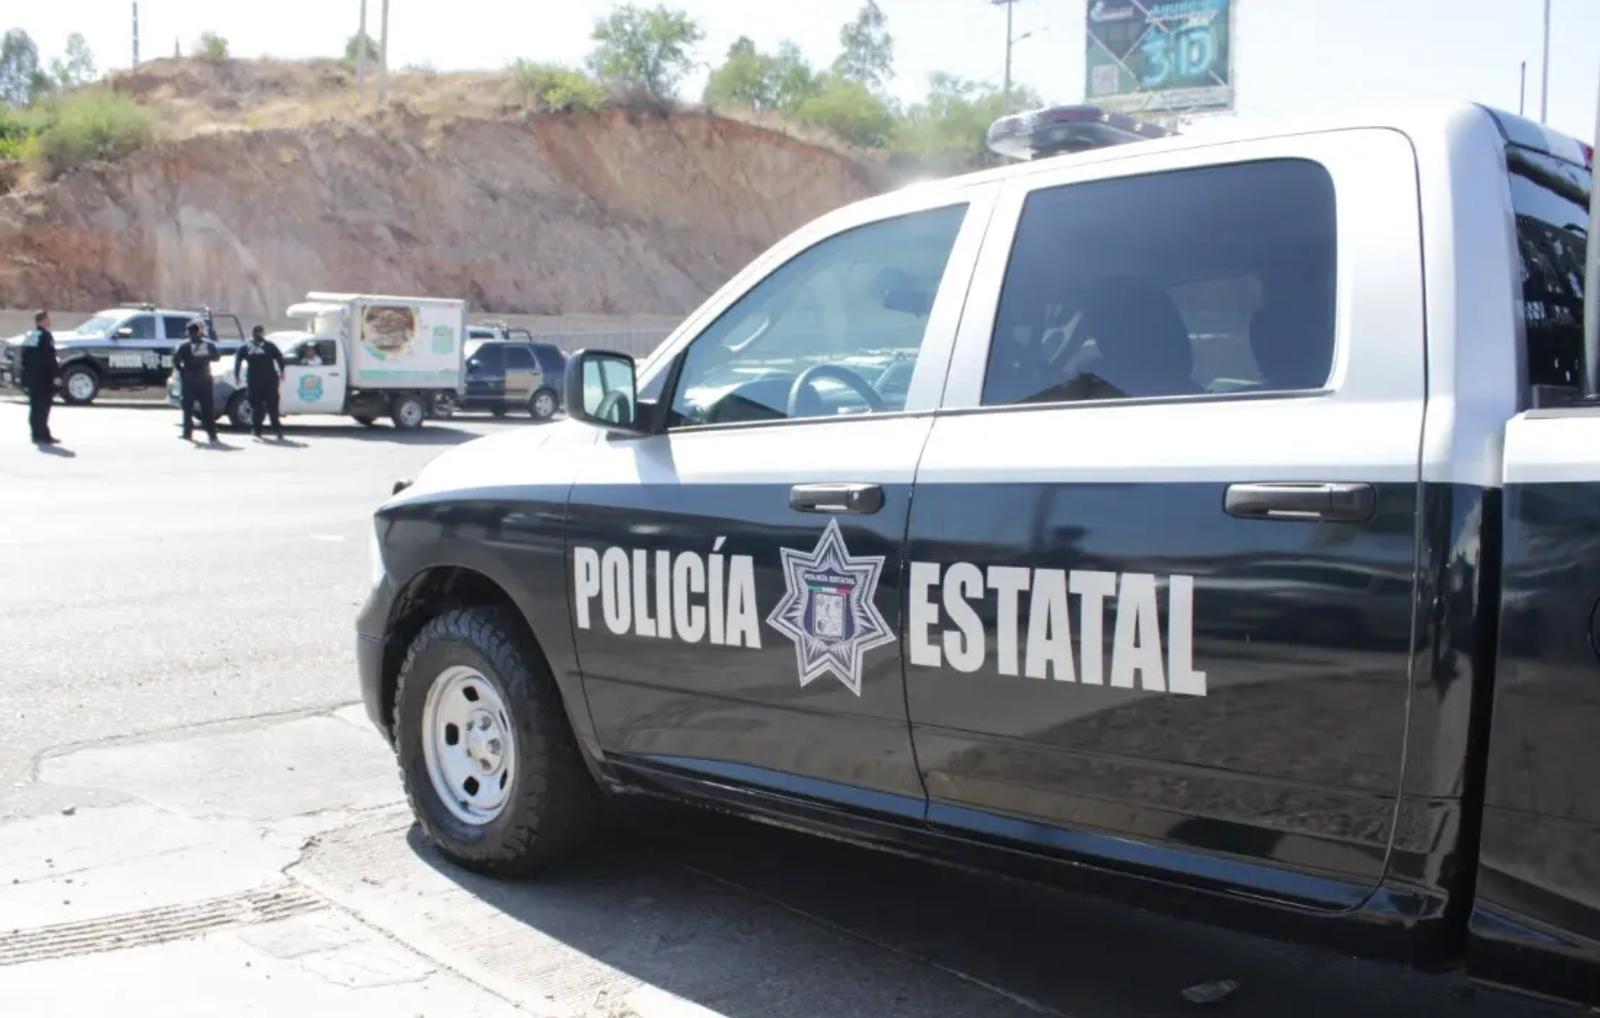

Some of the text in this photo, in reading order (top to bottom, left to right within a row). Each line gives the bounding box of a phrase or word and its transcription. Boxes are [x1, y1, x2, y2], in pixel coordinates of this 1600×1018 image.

[1141, 31, 1211, 86] 3D
[574, 536, 1207, 697] POLICÍA ESTATAL
